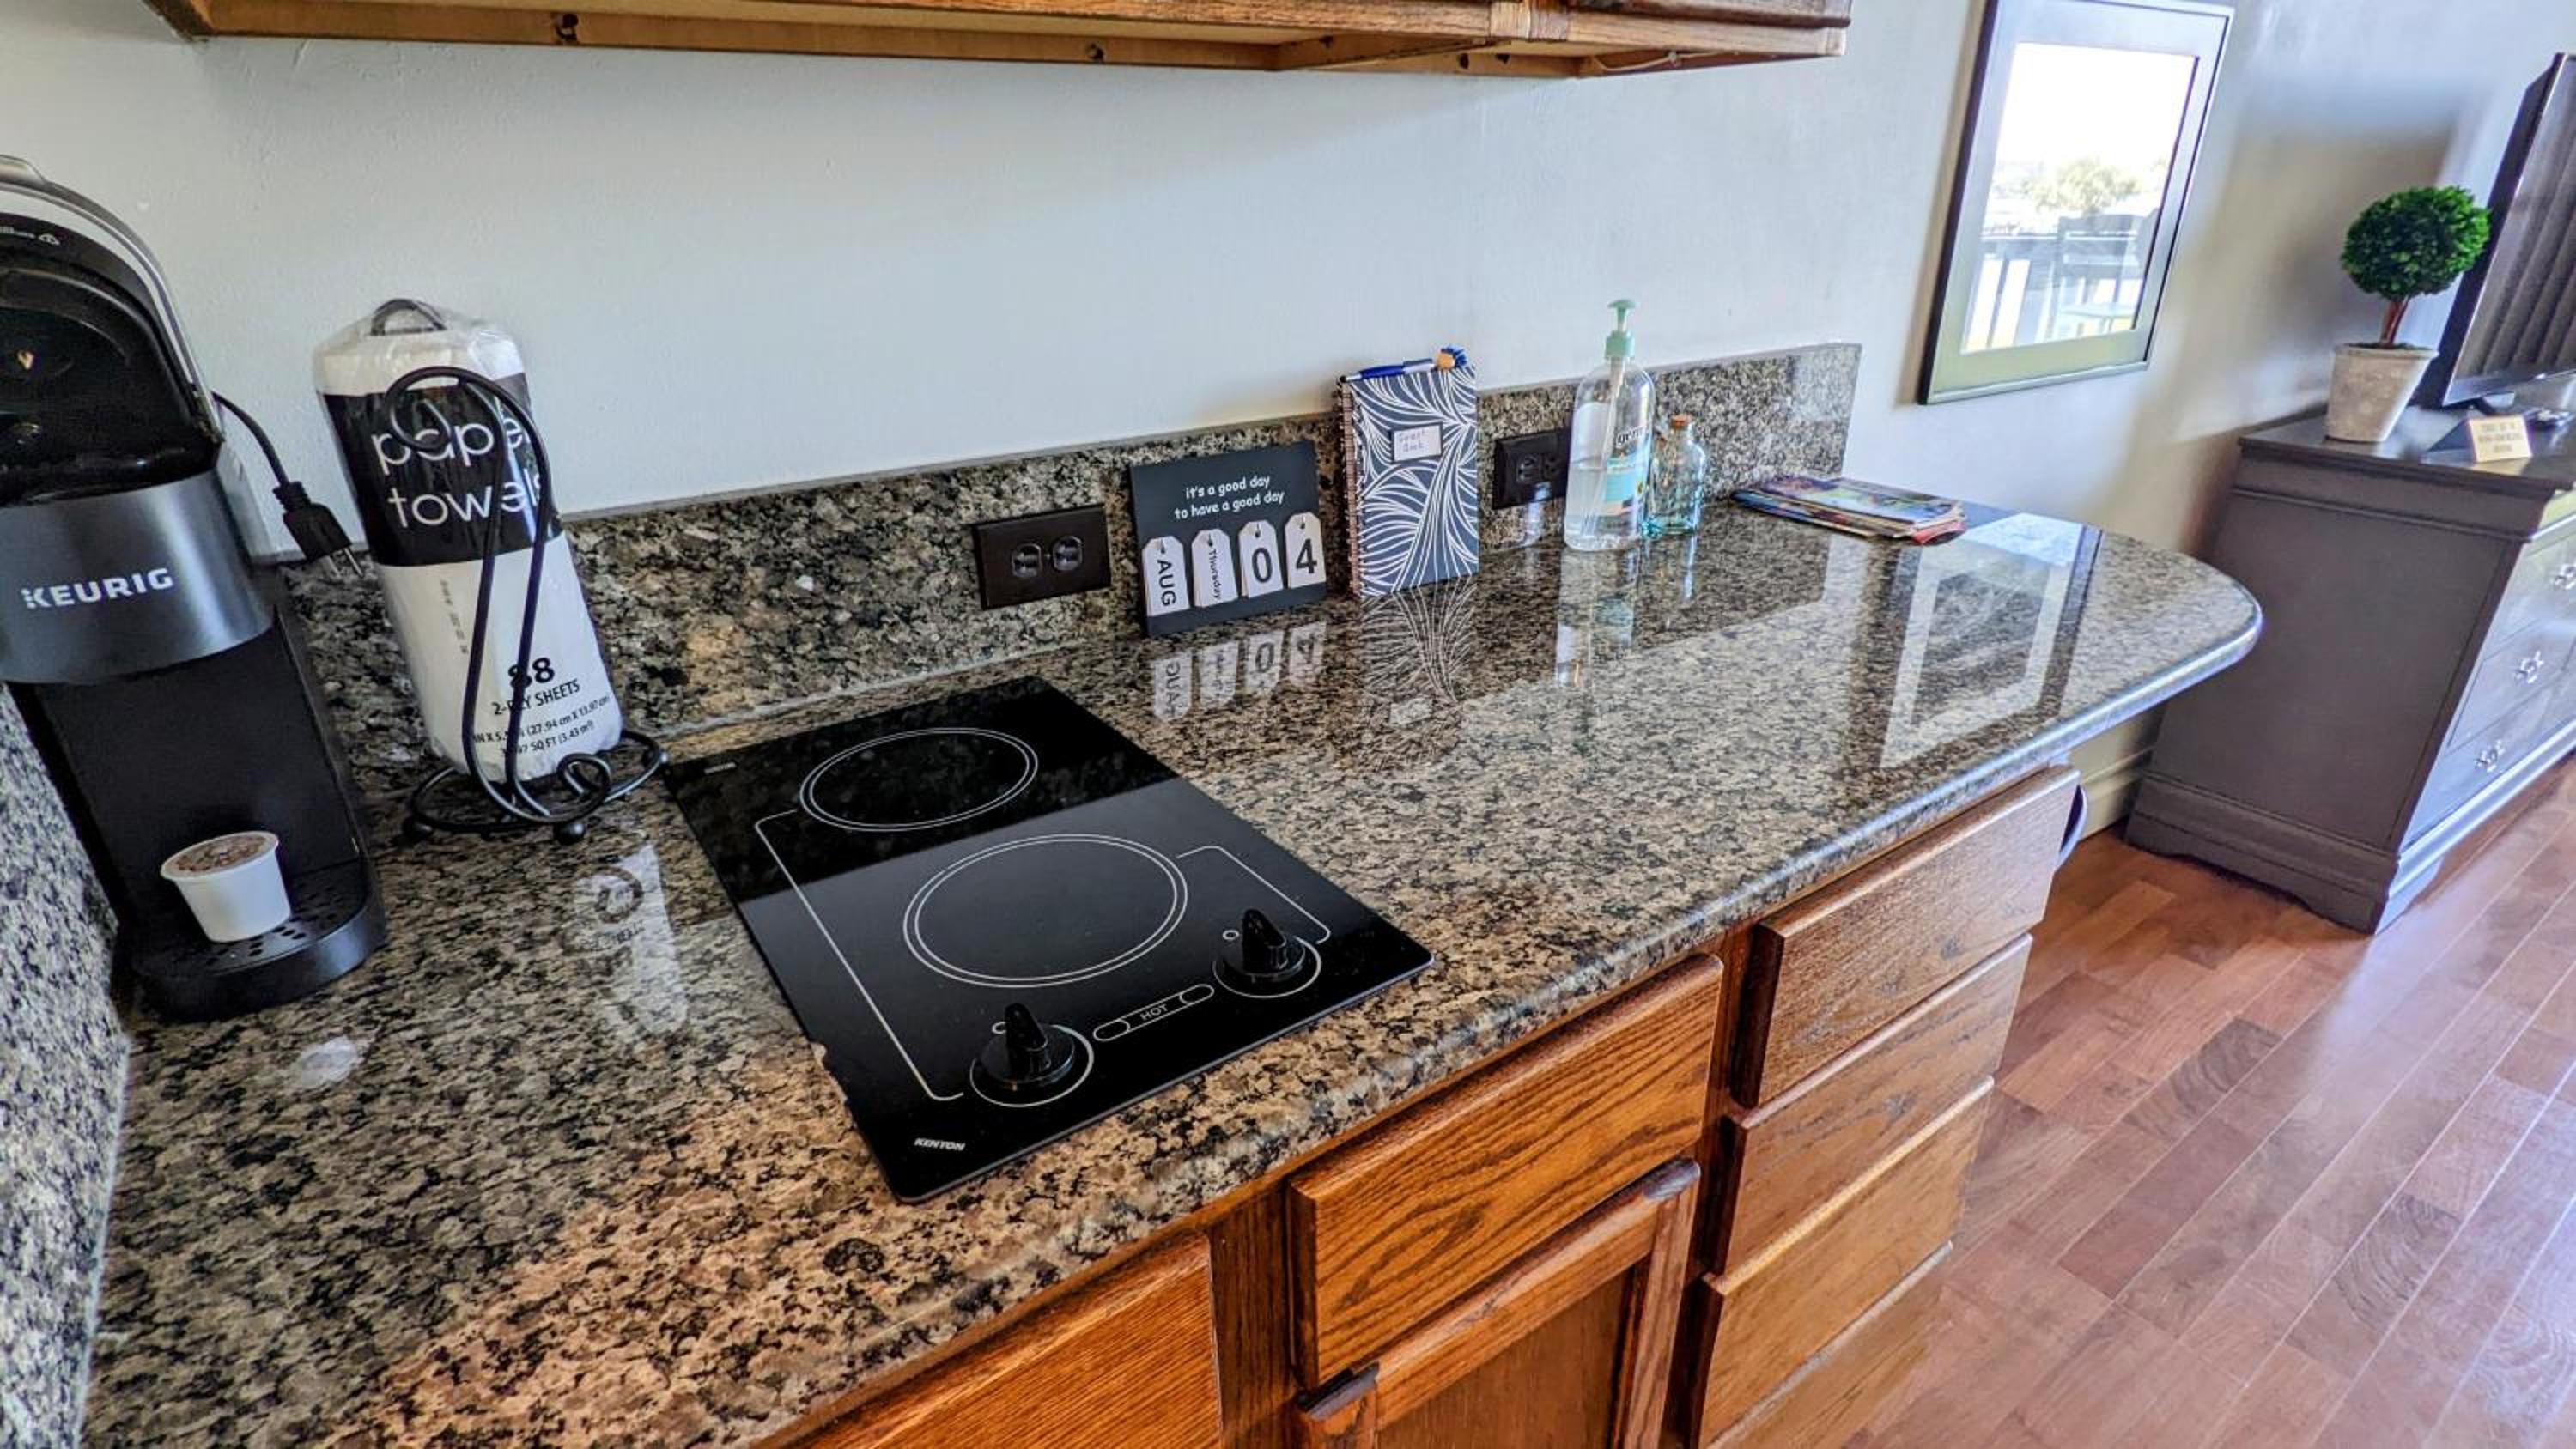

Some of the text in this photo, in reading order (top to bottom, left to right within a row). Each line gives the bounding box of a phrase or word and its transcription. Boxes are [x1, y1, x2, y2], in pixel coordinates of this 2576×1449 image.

[1186, 475, 1270, 499] it's a good day
[1174, 490, 1285, 519] to have a good day
[20, 567, 173, 609] KEURIG
[1157, 558, 1176, 607] AUG
[491, 679, 580, 715] 2-PY SHEETS
[531, 740, 544, 752] SQ
[546, 736, 556, 748] FT
[1140, 1003, 1169, 1021] HOT
